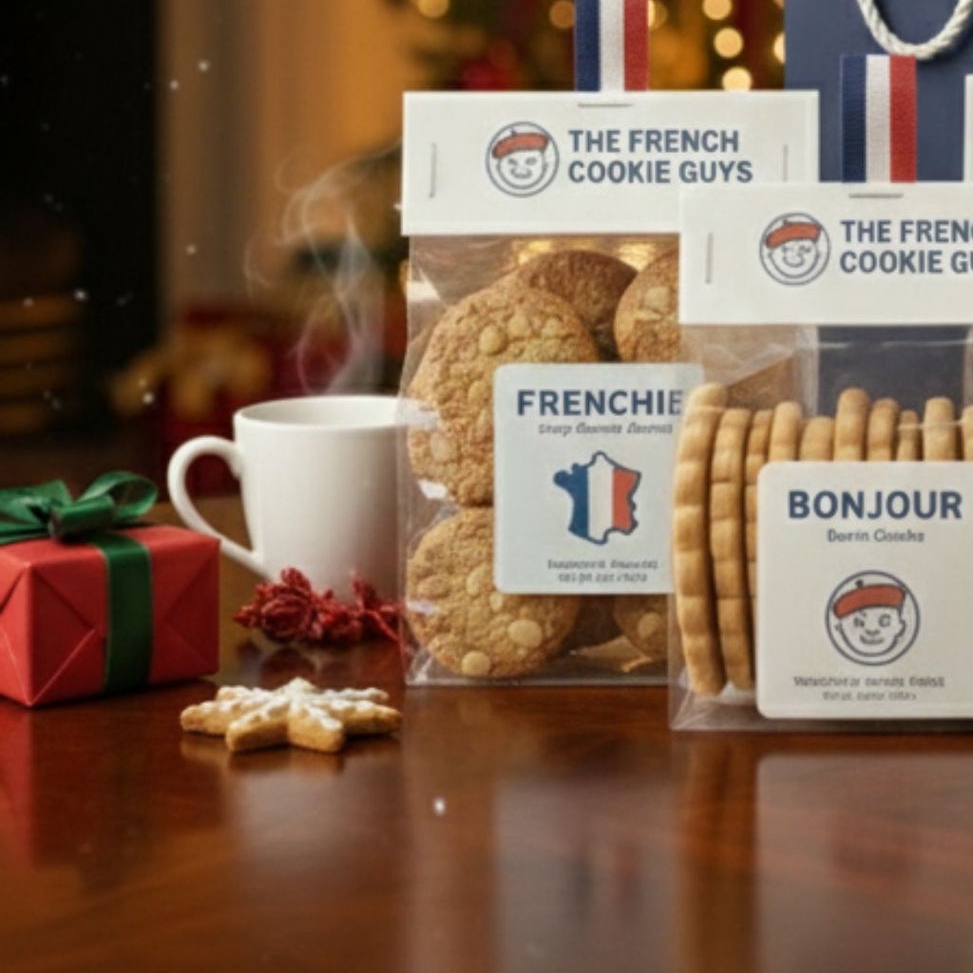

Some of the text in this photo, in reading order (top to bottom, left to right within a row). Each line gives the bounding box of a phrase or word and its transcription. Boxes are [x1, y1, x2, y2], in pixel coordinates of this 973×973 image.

[568, 129, 739, 153] THE FRENCH
[568, 160, 753, 183] COOKIE GUYS
[840, 220, 892, 243] THE
[840, 250, 943, 274] COOKIE
[517, 390, 684, 416] FRENCHIE
[788, 490, 963, 519] BONJOUR
